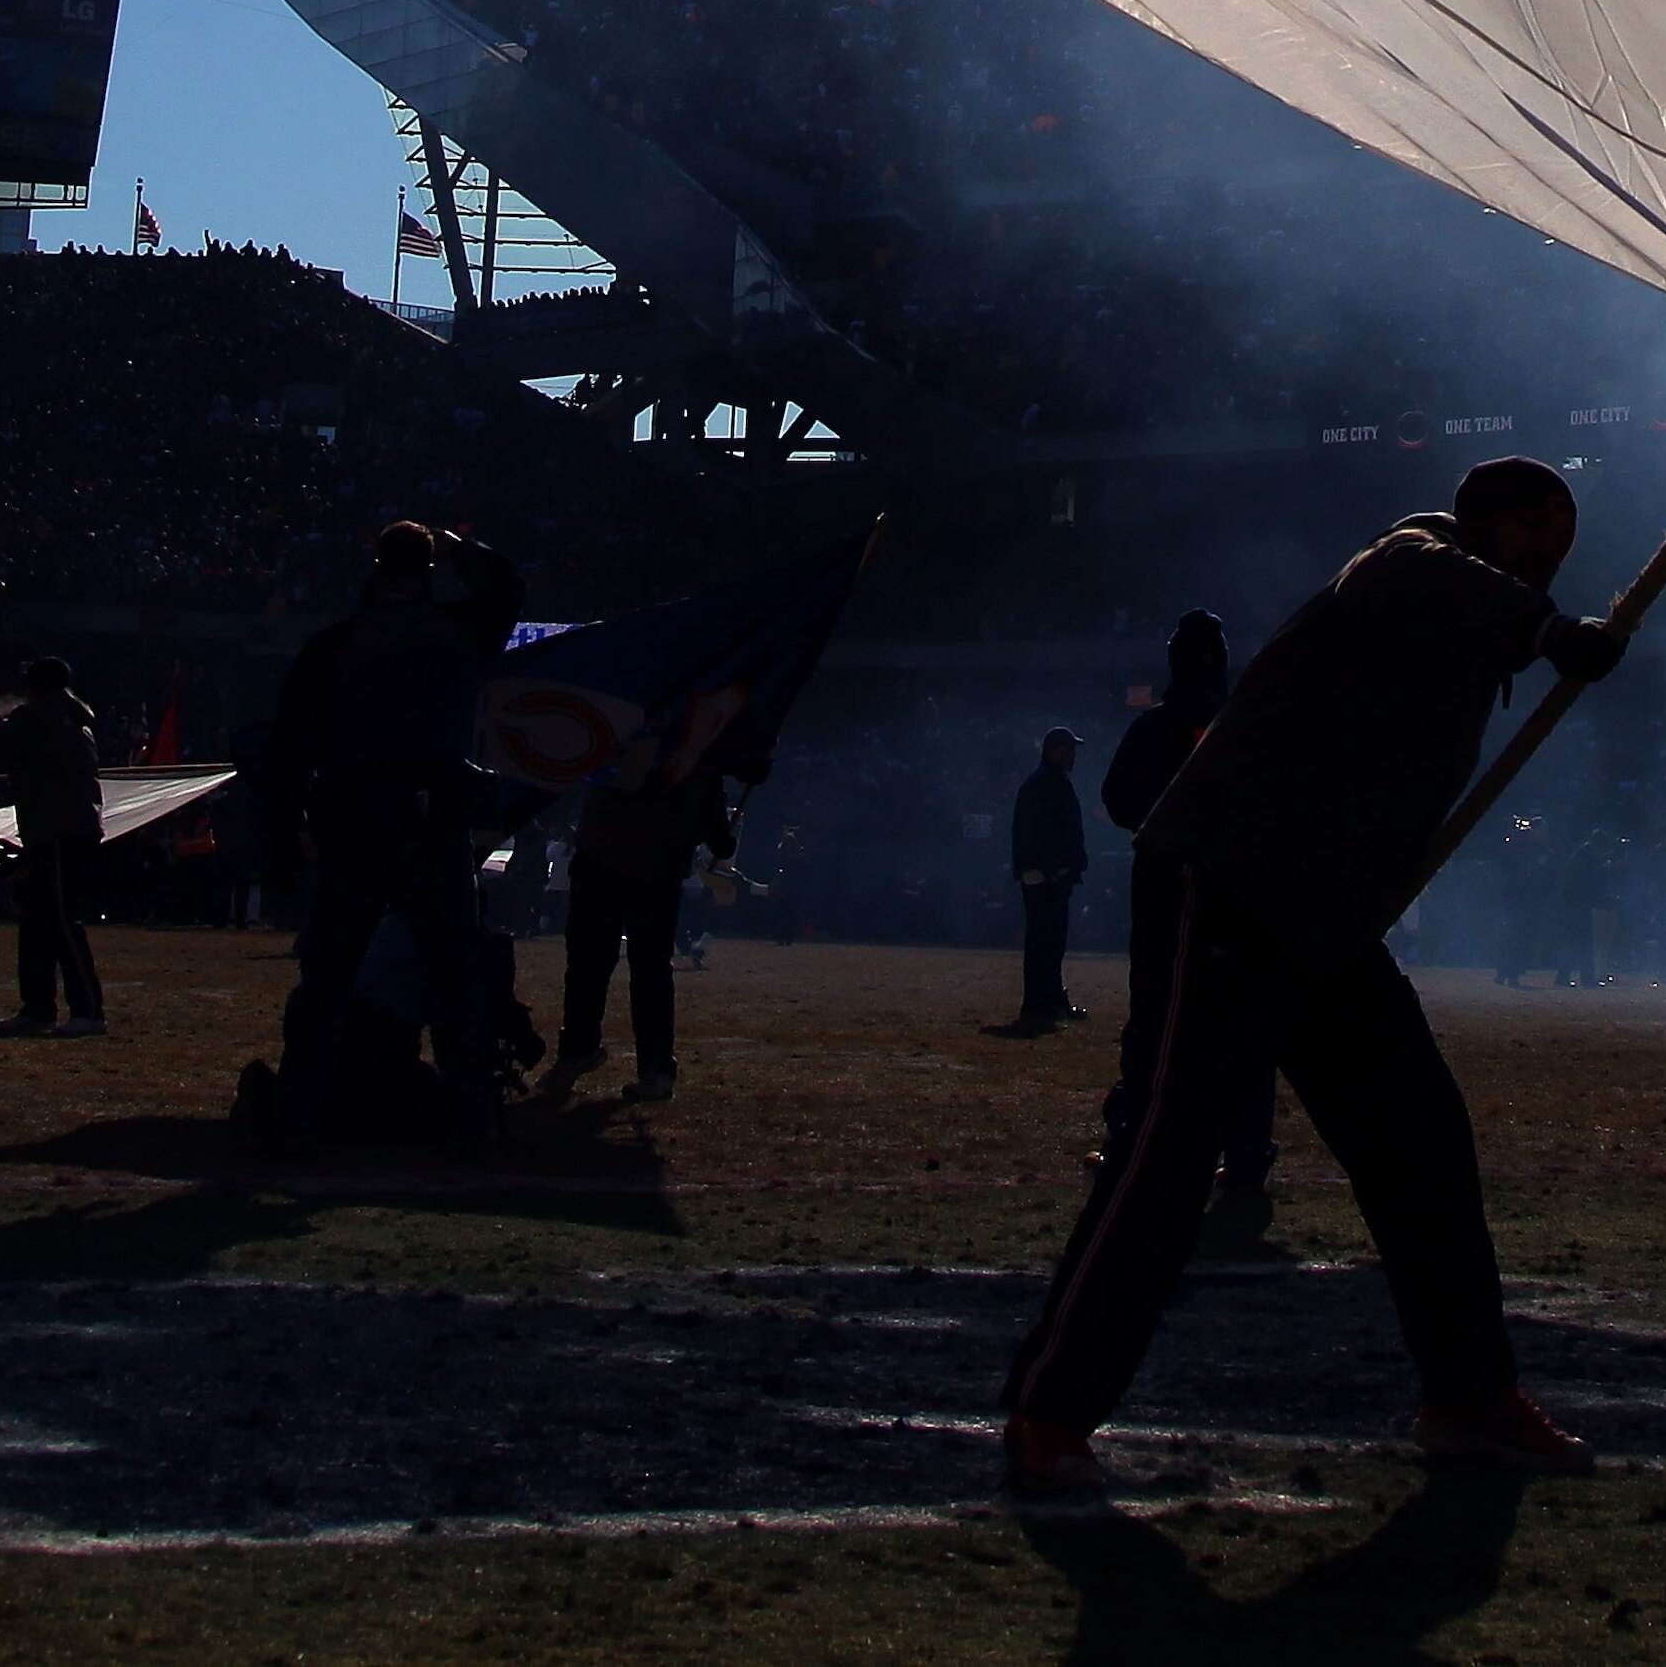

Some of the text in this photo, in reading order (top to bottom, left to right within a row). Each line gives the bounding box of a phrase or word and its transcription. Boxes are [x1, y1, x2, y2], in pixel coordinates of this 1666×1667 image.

[1570, 409, 1597, 425] ONE
[1601, 406, 1630, 422] CITY
[1323, 427, 1347, 443] ONE
[1350, 425, 1379, 442] CITY
[1446, 418, 1471, 434] ONE
[1475, 415, 1513, 432] TEAM
